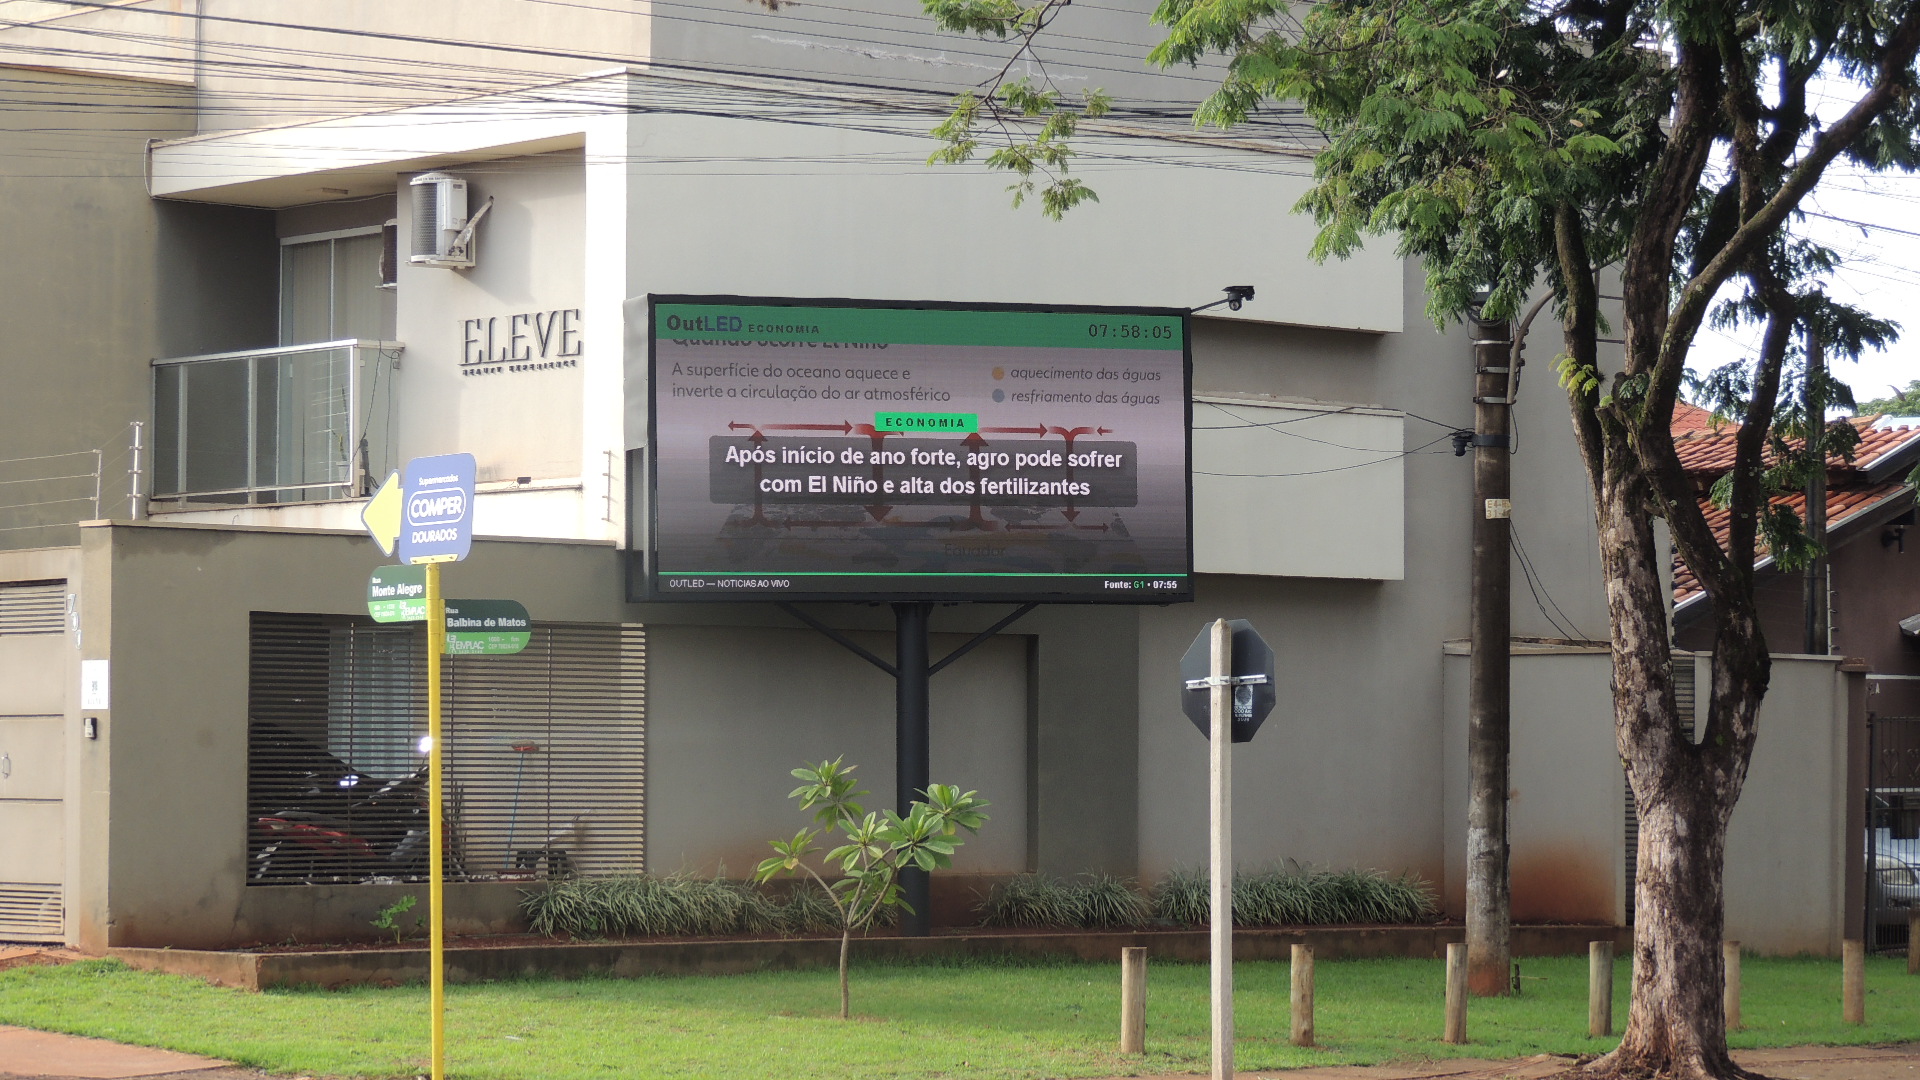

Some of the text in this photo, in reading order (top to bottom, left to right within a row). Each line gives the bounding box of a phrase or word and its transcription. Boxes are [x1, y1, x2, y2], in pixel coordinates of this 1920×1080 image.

[666, 315, 820, 334] OutLED ECONOMIA
[1088, 324, 1172, 339] 07:58:05
[457, 308, 583, 367] ELEVE
[671, 362, 911, 382] A superfície do oceano aquece e
[1010, 366, 1161, 383] aquecimento das águas
[672, 383, 951, 402] inverte a circulação do ar atmosférico
[1011, 389, 1160, 407] resfriamento das águas
[885, 417, 965, 428] ECONOMIA
[725, 445, 1123, 471] Após início de ano forte, agro pode sofrer
[759, 475, 1091, 496] com El Niño e alta dos fertilizantes
[410, 495, 462, 518] COMPER
[411, 527, 458, 544] DOURADOS
[372, 583, 423, 597] Monte Alegre
[669, 579, 705, 588] OUTLED
[770, 579, 790, 588] VIVO
[1104, 580, 1132, 589] Fonte:
[1133, 580, 1144, 589] G1
[1152, 580, 1178, 589] 07:55
[446, 617, 527, 628] Balbina de Matos
